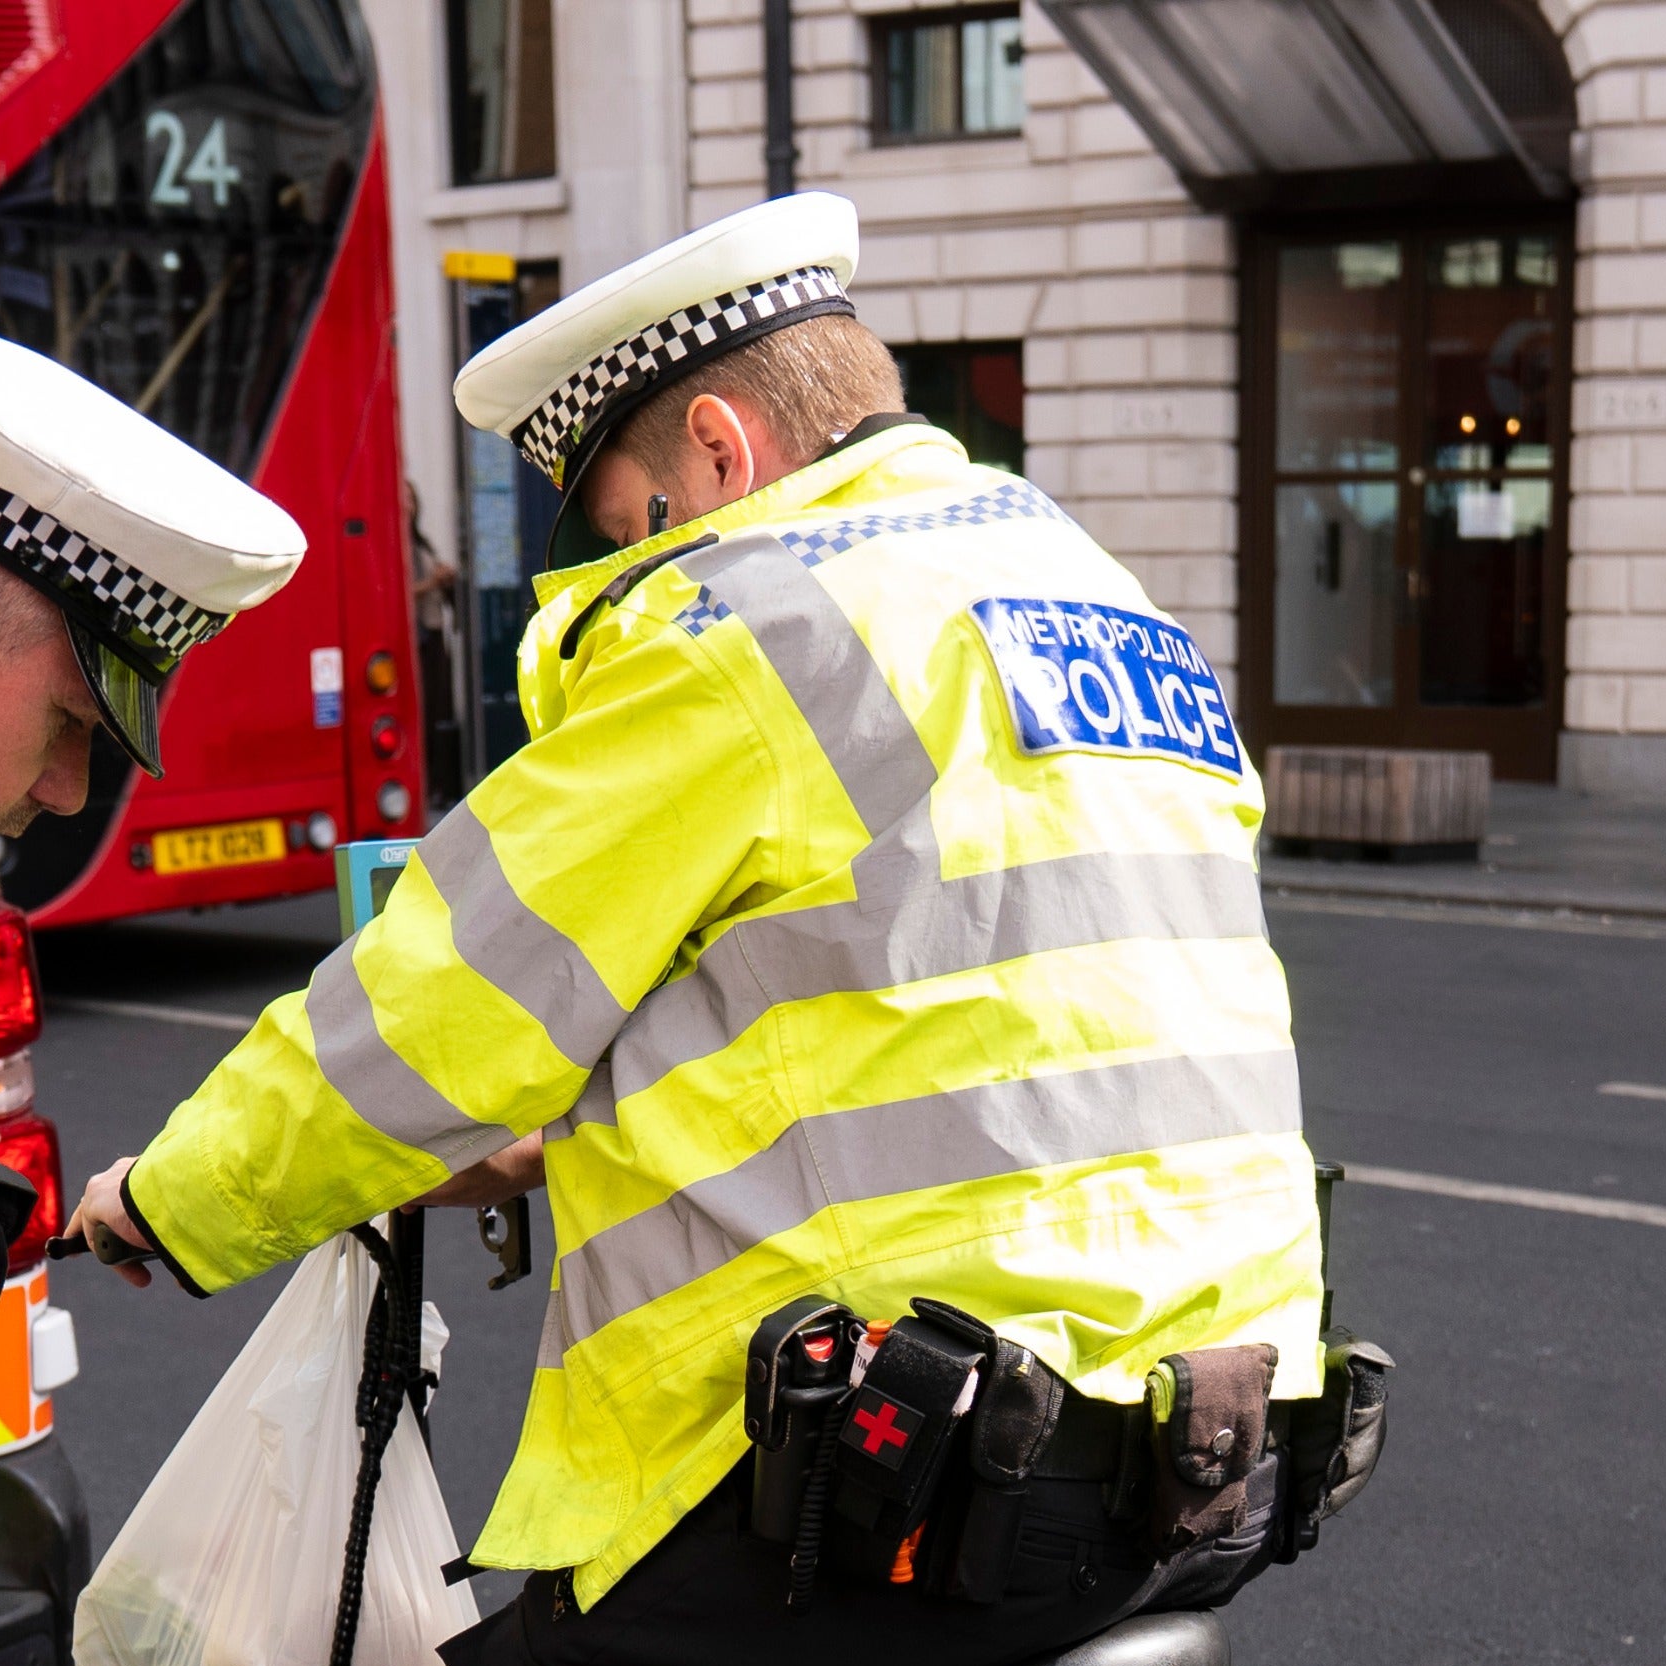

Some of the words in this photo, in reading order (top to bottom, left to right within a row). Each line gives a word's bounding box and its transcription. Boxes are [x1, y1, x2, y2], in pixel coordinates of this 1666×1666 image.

[145, 110, 241, 207] 24
[997, 609, 1212, 678] METROPOLITAN
[1021, 654, 1237, 760] POLICE
